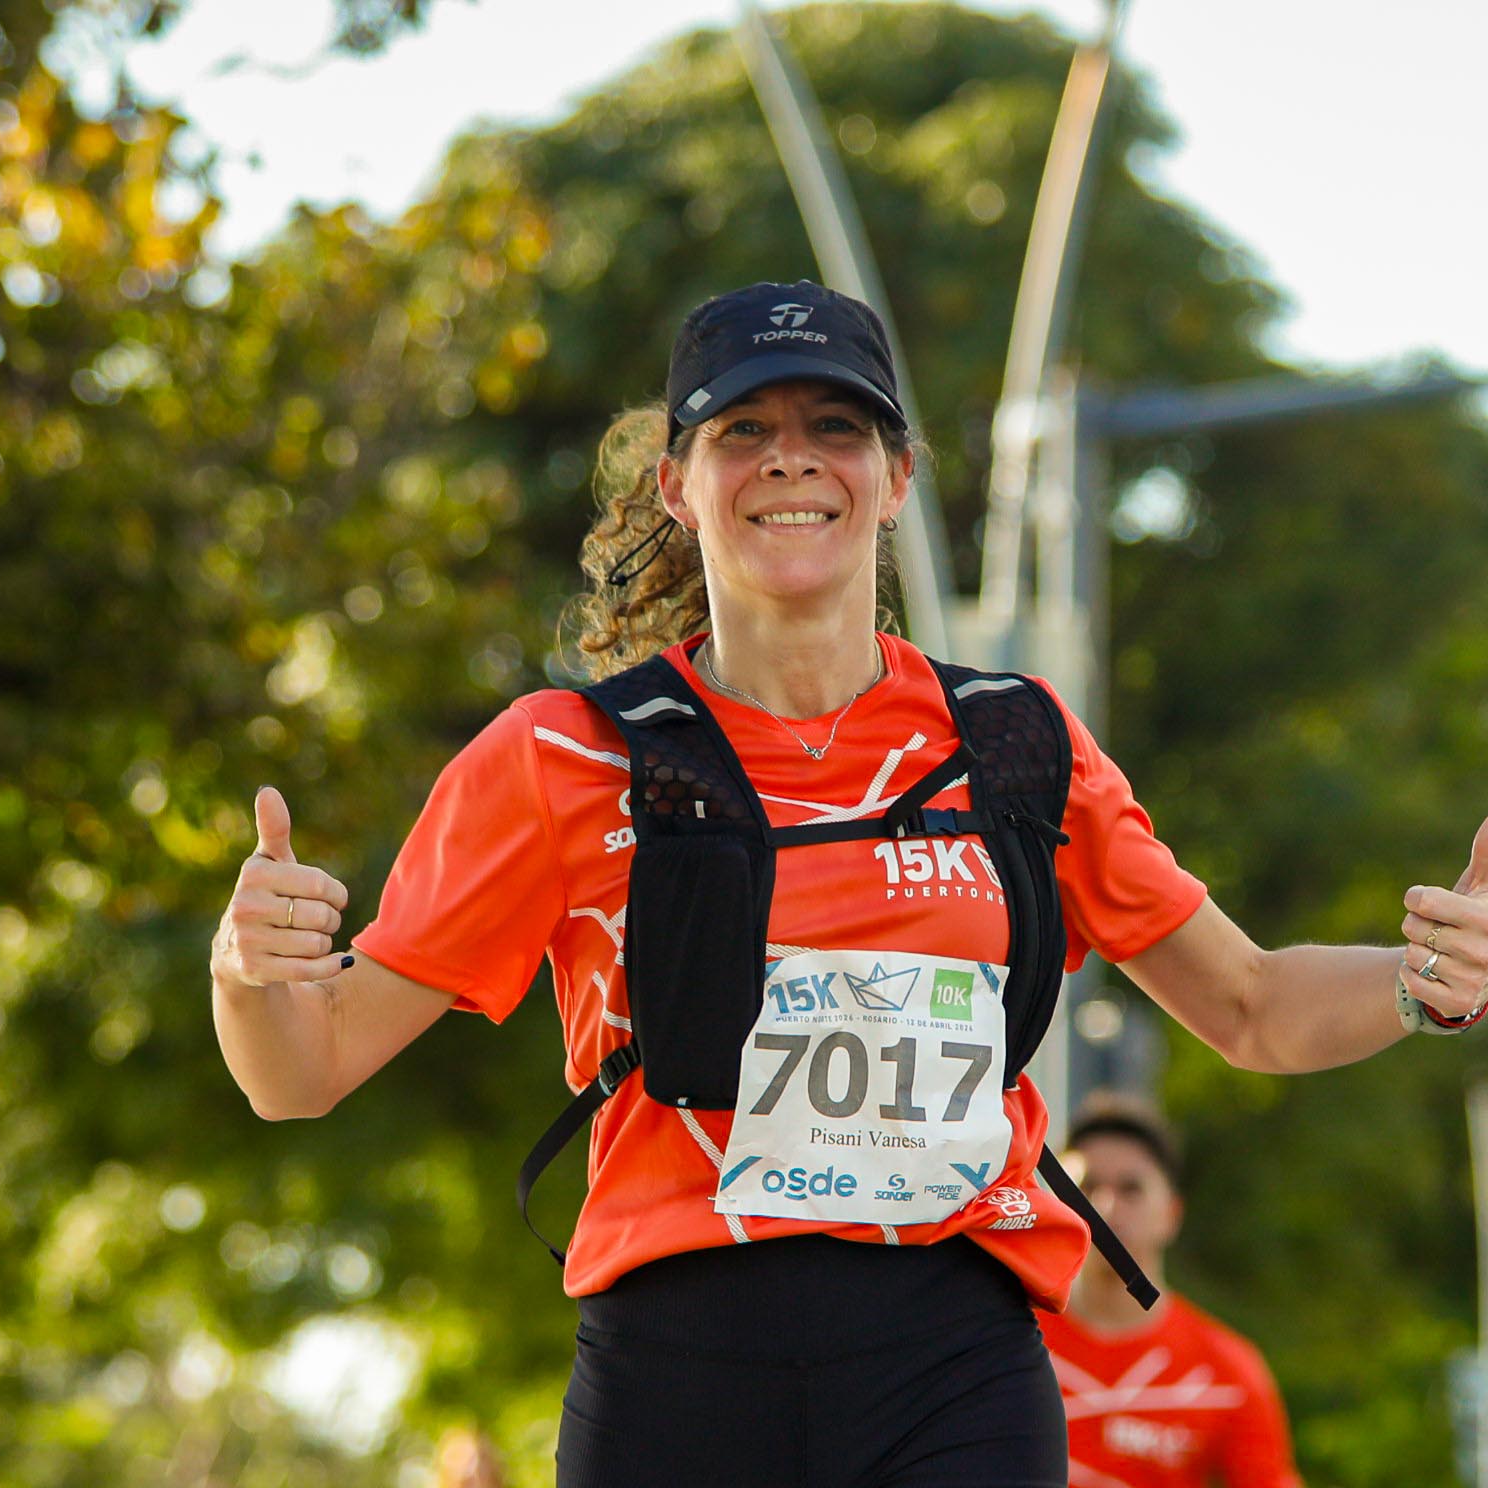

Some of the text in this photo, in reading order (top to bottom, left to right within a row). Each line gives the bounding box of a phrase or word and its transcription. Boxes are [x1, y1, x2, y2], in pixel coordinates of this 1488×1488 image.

[752, 330, 828, 345] TOPPER
[873, 839, 976, 884] 15K
[886, 885, 979, 900] PUERTO
[767, 971, 840, 1014] 15K
[936, 984, 967, 1007] 10K
[775, 1015, 810, 1023] PUERTO
[862, 1015, 898, 1024] ROSARIO
[917, 1019, 927, 1027] DE
[929, 1020, 952, 1030] ABRIL
[749, 1031, 993, 1122] 7017
[810, 1128, 927, 1148] Pisani Vanesa
[762, 1165, 857, 1198] osde
[924, 1184, 962, 1194] POWER
[987, 1213, 1038, 1230] ARDEC
